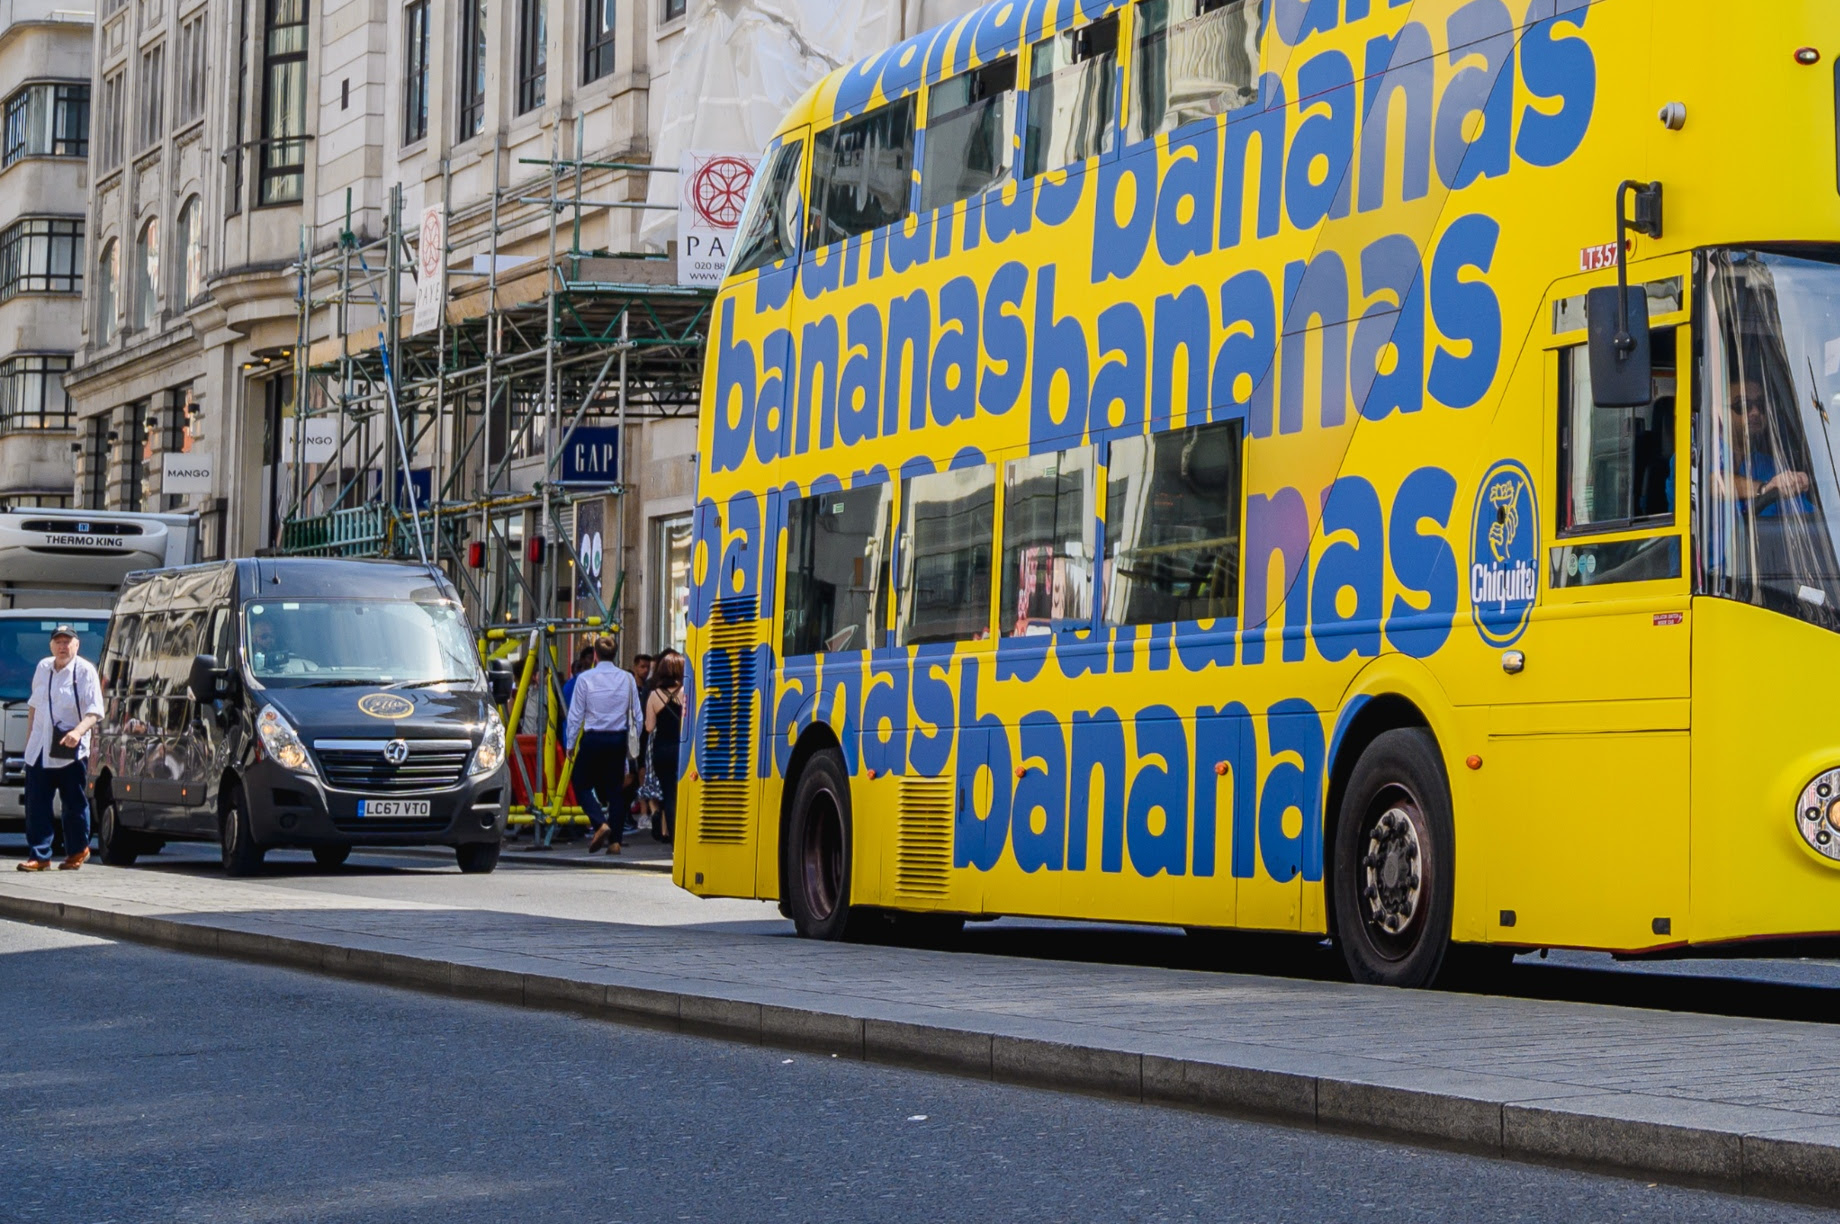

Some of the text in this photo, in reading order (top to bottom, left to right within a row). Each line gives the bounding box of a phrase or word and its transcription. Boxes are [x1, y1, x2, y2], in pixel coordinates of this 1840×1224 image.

[687, 235, 726, 257] PA
[695, 261, 726, 270] 020 88
[690, 272, 722, 280] www.
[1029, 213, 1502, 458] bananas
[712, 260, 1030, 474] bananas
[289, 437, 333, 445] MNGO
[575, 443, 613, 473] GAP
[167, 469, 210, 478] MANGO
[45, 535, 123, 547] THERMO KING
[1471, 561, 1537, 615] Chiquita
[953, 657, 1372, 883] banana
[366, 802, 428, 815] LC67 VTO
